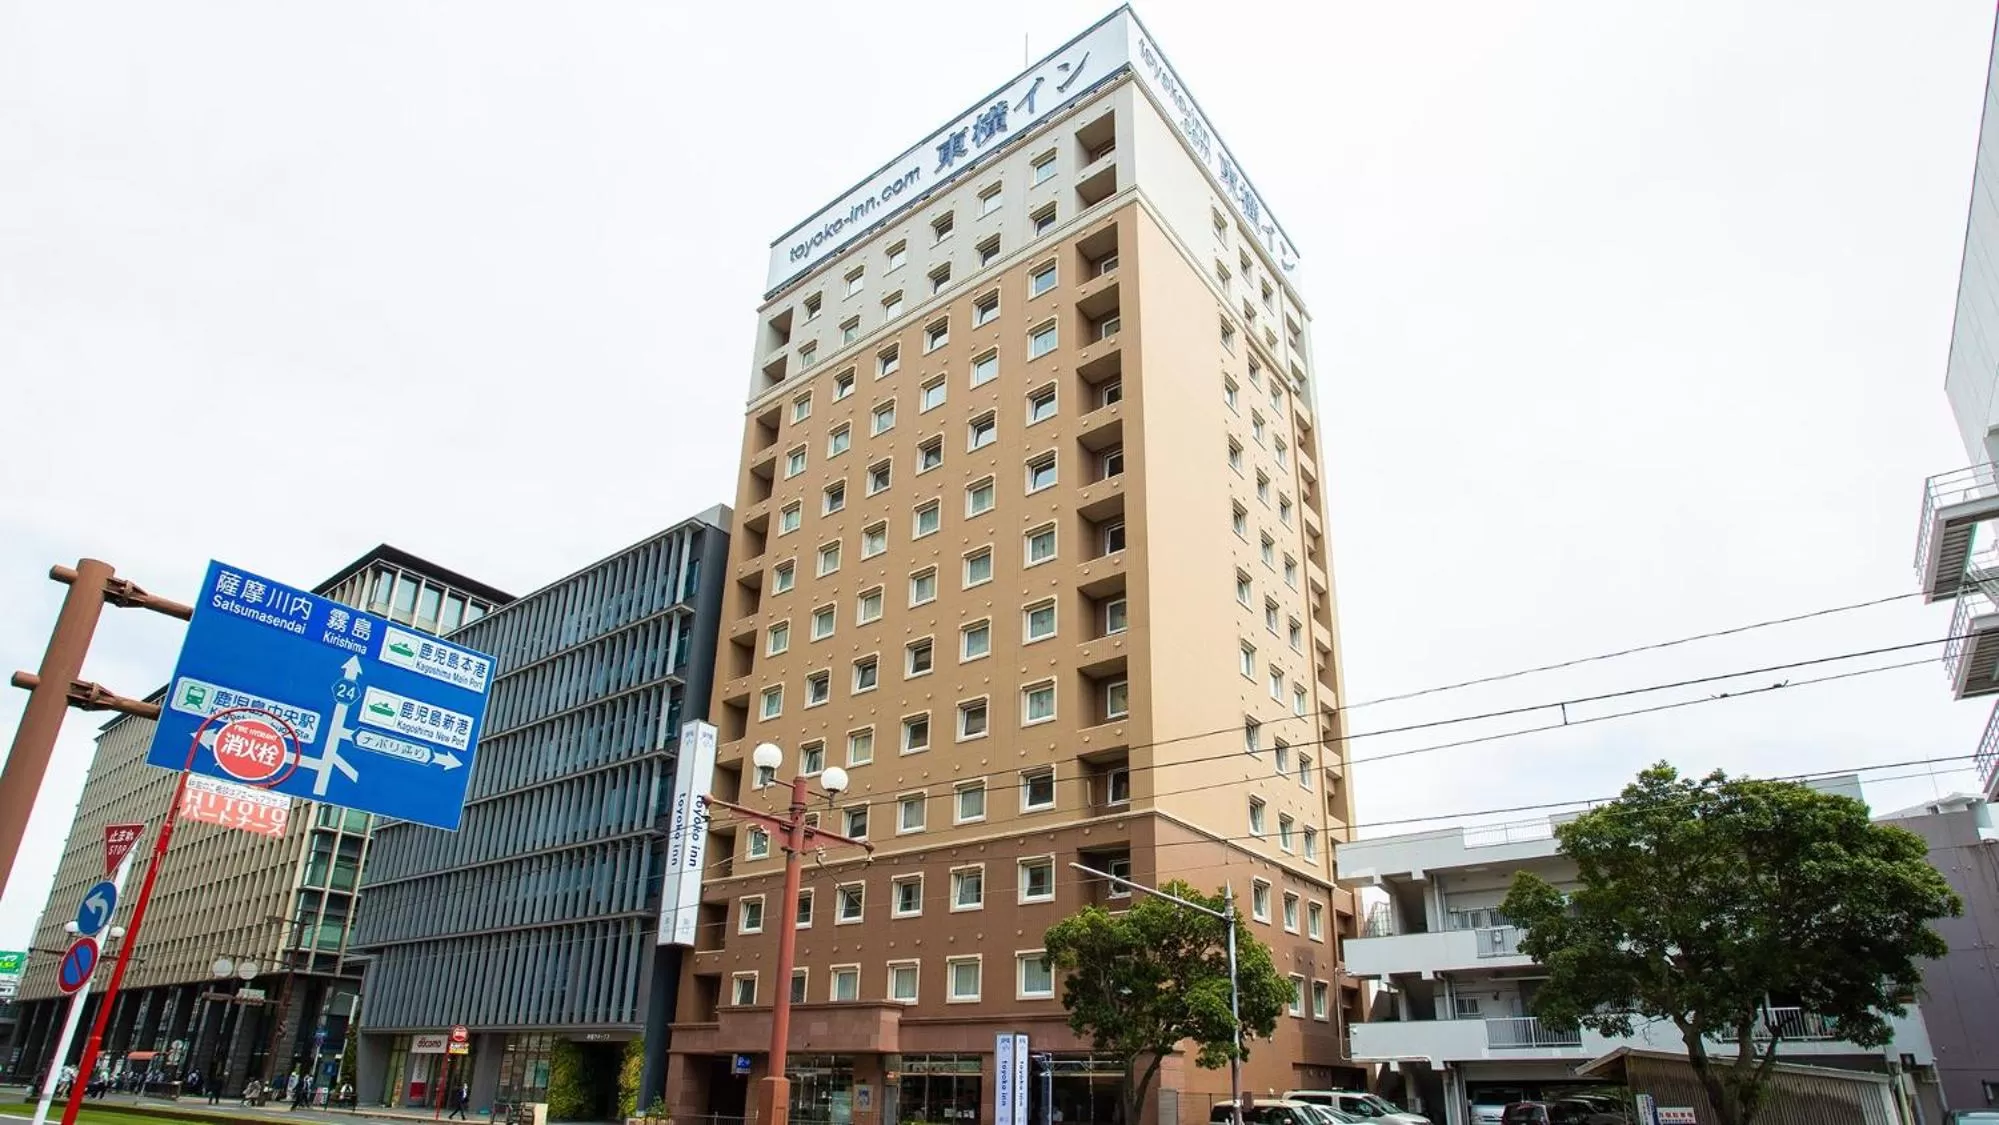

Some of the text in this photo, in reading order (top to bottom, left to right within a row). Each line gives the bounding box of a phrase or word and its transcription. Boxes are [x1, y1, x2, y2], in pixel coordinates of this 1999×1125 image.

[935, 51, 1090, 174] 東横イン
[789, 166, 921, 263] toyoko-inn.com
[1218, 152, 1295, 272] 東横イン
[214, 570, 313, 621] 薩摩川内
[212, 595, 307, 635] Satsumasendai
[326, 608, 373, 642] 霧島
[323, 631, 368, 660] Kirishima
[420, 643, 487, 678] 鹿児島本港
[415, 660, 452, 679] Kagoshima
[336, 683, 355, 700] 24
[397, 721, 433, 739] Kagoshima
[400, 701, 469, 735] 鹿児島新港
[221, 732, 279, 767] 消火栓
[108, 829, 134, 842] 止まれ
[671, 792, 687, 866] toyoko inn
[689, 845, 700, 867] inn
